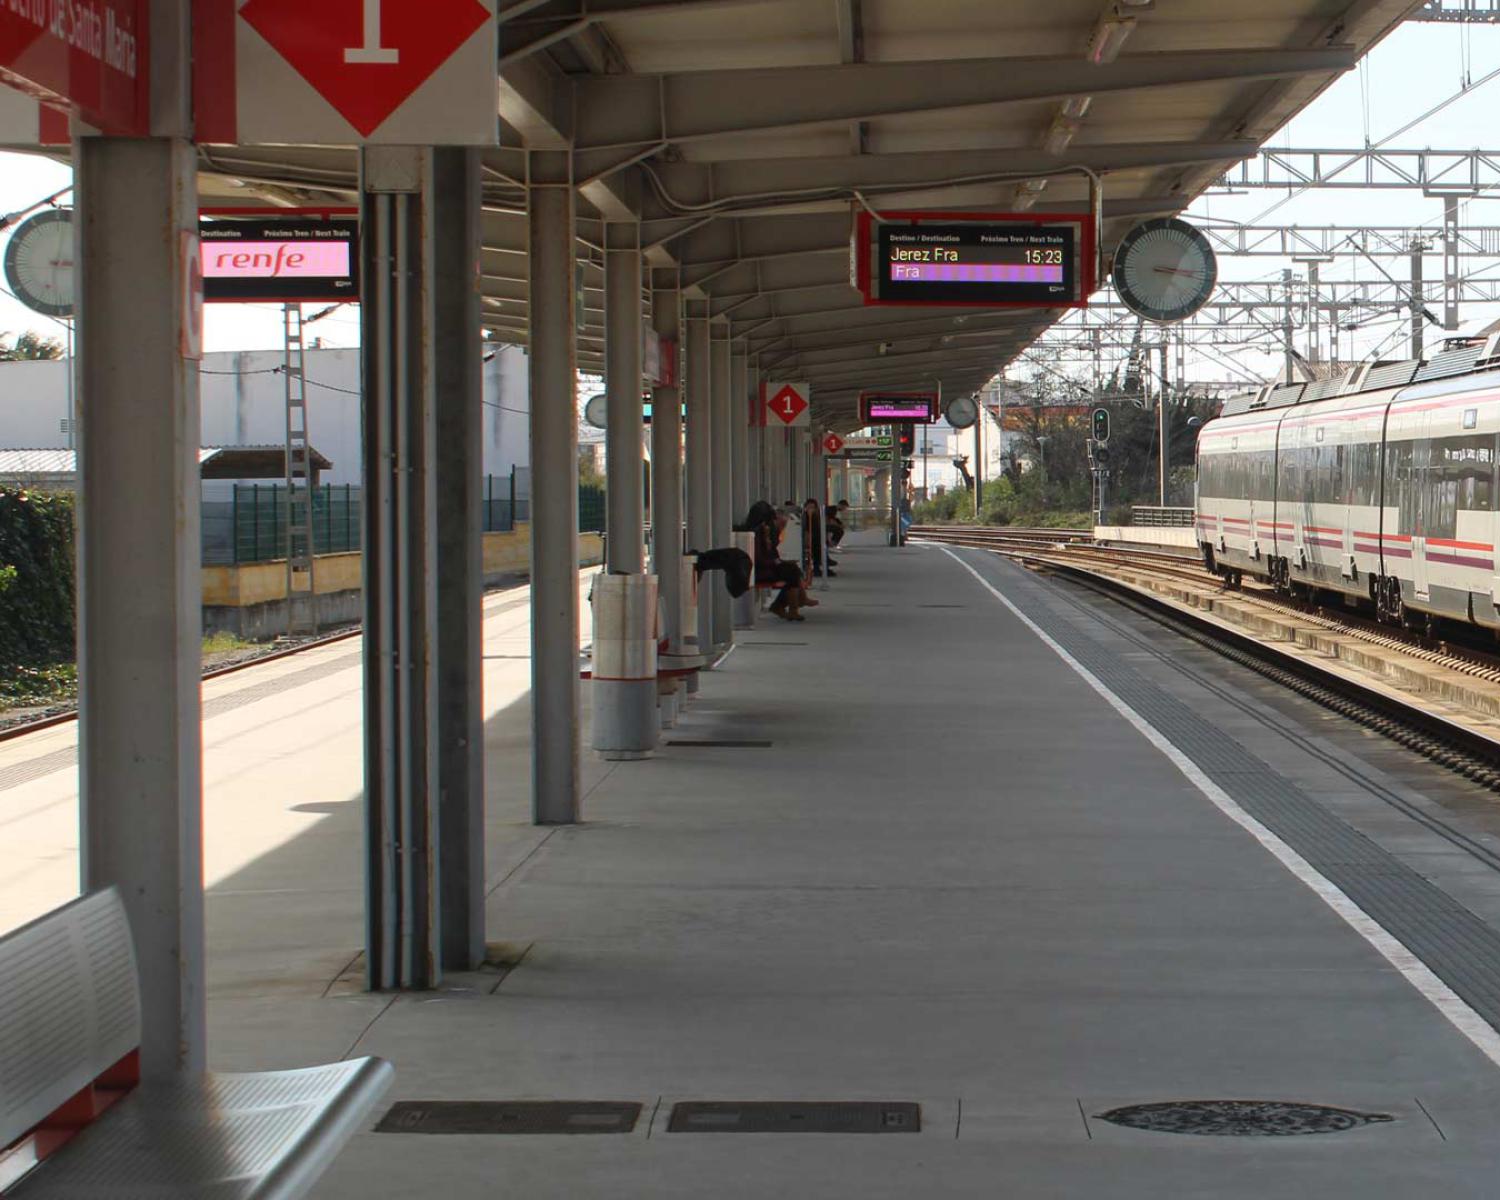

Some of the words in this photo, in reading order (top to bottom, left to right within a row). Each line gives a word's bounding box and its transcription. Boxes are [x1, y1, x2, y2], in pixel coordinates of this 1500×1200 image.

[68, 0, 101, 60] Santa
[344, 0, 399, 64] 1
[201, 229, 242, 237] Destination
[216, 244, 305, 277] renfe
[890, 247, 930, 261] Jerez
[934, 248, 958, 261] Fra
[1024, 249, 1062, 263] 15:23
[896, 265, 920, 278] Fra
[783, 395, 794, 413] 1
[830, 439, 837, 449] 1
